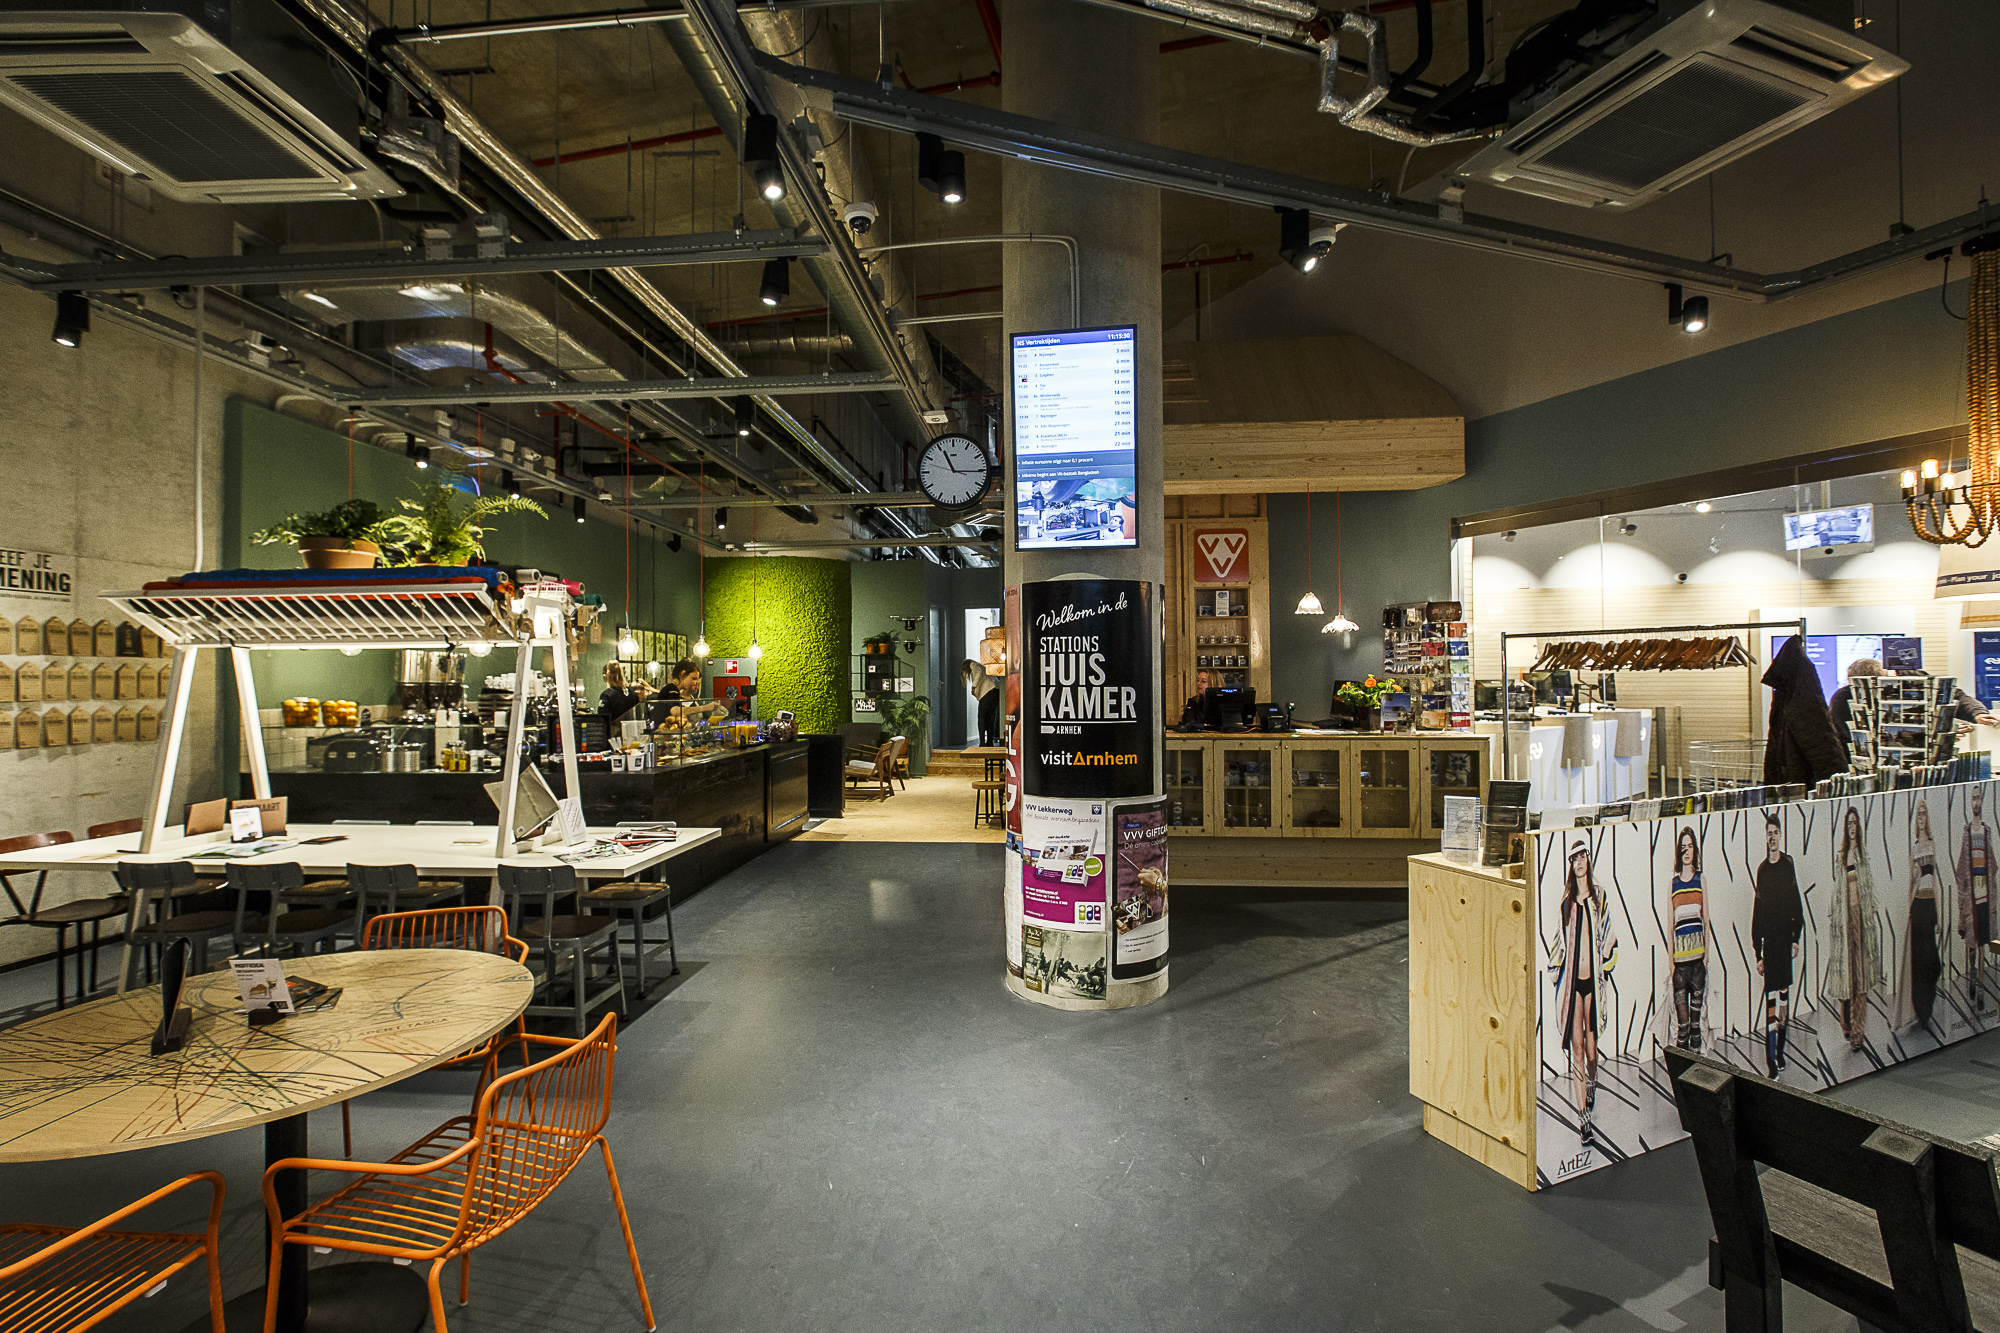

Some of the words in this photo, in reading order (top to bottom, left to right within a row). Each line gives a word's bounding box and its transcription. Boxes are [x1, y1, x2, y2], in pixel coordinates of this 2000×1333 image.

[33, 553, 52, 570] JE
[1967, 574, 1988, 583] your
[1036, 603, 1096, 631] Welkom
[1097, 600, 1113, 615] in
[1114, 591, 1128, 611] de
[1040, 635, 1100, 653] STATIONS
[1040, 653, 1106, 686] HUIS
[1040, 686, 1137, 719] KAMER
[1056, 725, 1082, 735] ARNHEM
[1038, 806, 1073, 815] Lekkerweg
[1123, 830, 1144, 841] VVV
[1557, 1150, 1592, 1176] ArtEZ
